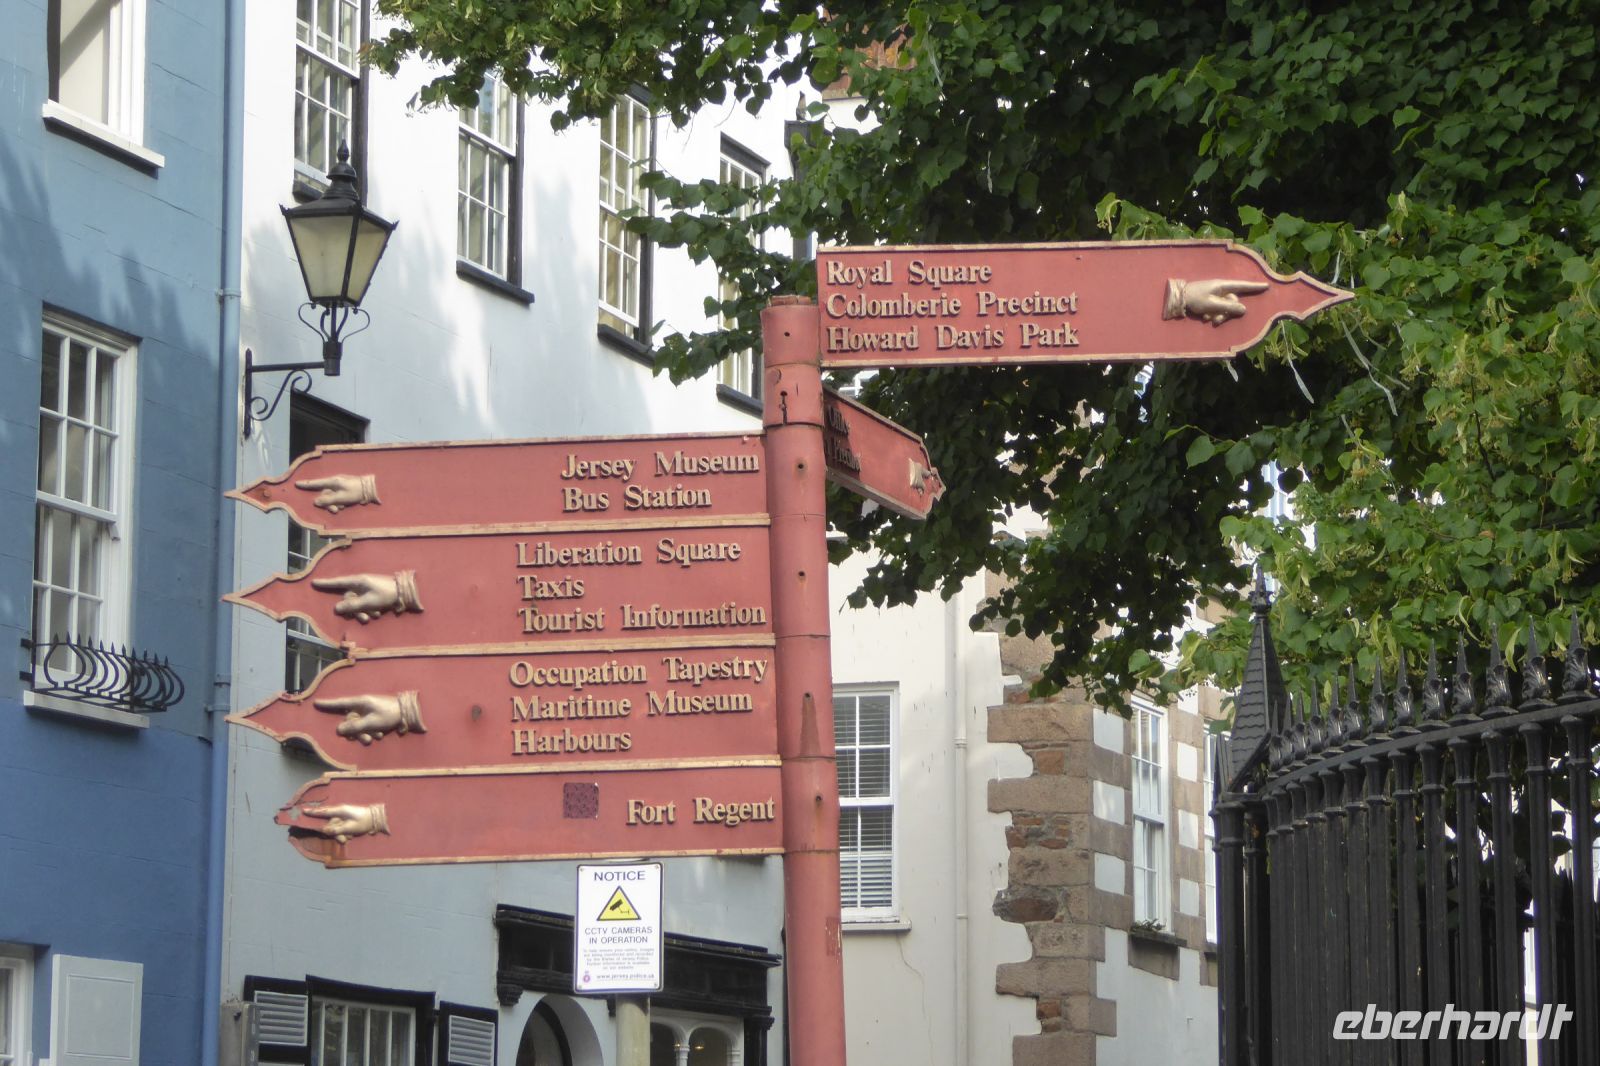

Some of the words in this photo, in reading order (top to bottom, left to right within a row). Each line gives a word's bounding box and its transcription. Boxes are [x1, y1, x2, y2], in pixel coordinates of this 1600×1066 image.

[827, 260, 892, 288] Royal
[908, 261, 992, 289] Square
[826, 292, 962, 318] Colomberie
[977, 291, 1078, 316] Precinct
[827, 326, 919, 351] Howard
[936, 324, 1004, 349] Davis
[1020, 322, 1080, 347] Park
[561, 454, 636, 481] Jersey
[654, 451, 760, 476] Museum
[562, 487, 610, 512] Bus
[624, 484, 713, 510] Station
[515, 541, 643, 567] Liberation
[656, 538, 741, 567] Square
[516, 575, 585, 600] Taxis
[517, 607, 605, 633] Tourist
[620, 602, 767, 629] Information
[509, 660, 647, 690] Occupation
[662, 656, 768, 685] Tapestry
[511, 695, 633, 721] Maritime
[647, 690, 753, 716] Museum
[512, 728, 633, 754] Harbours
[626, 799, 676, 825] Fort
[692, 796, 776, 827] Regent
[594, 871, 646, 881] NOTICE
[584, 927, 608, 935] CCTV
[611, 926, 653, 935] CAMERAS
[589, 937, 597, 945] IN
[600, 936, 648, 945] OPERATION
